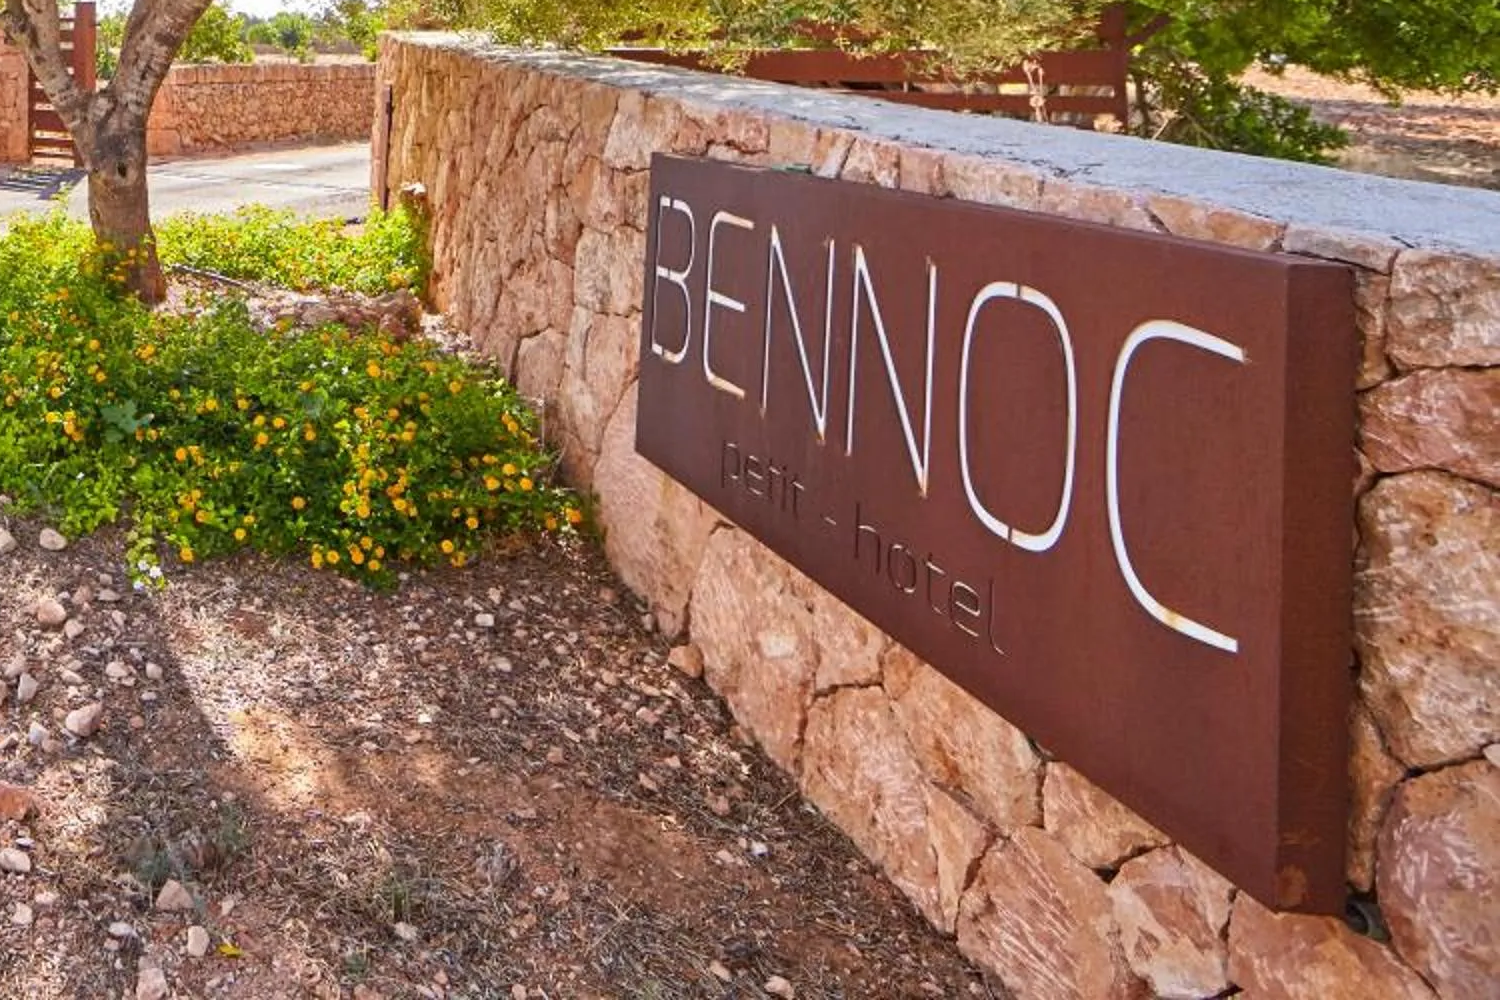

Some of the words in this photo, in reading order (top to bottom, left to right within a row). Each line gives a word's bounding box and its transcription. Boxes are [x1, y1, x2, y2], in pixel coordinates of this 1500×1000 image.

[649, 195, 1248, 654] BENNOC
[720, 439, 805, 520] petit
[854, 501, 1008, 656] hotel
